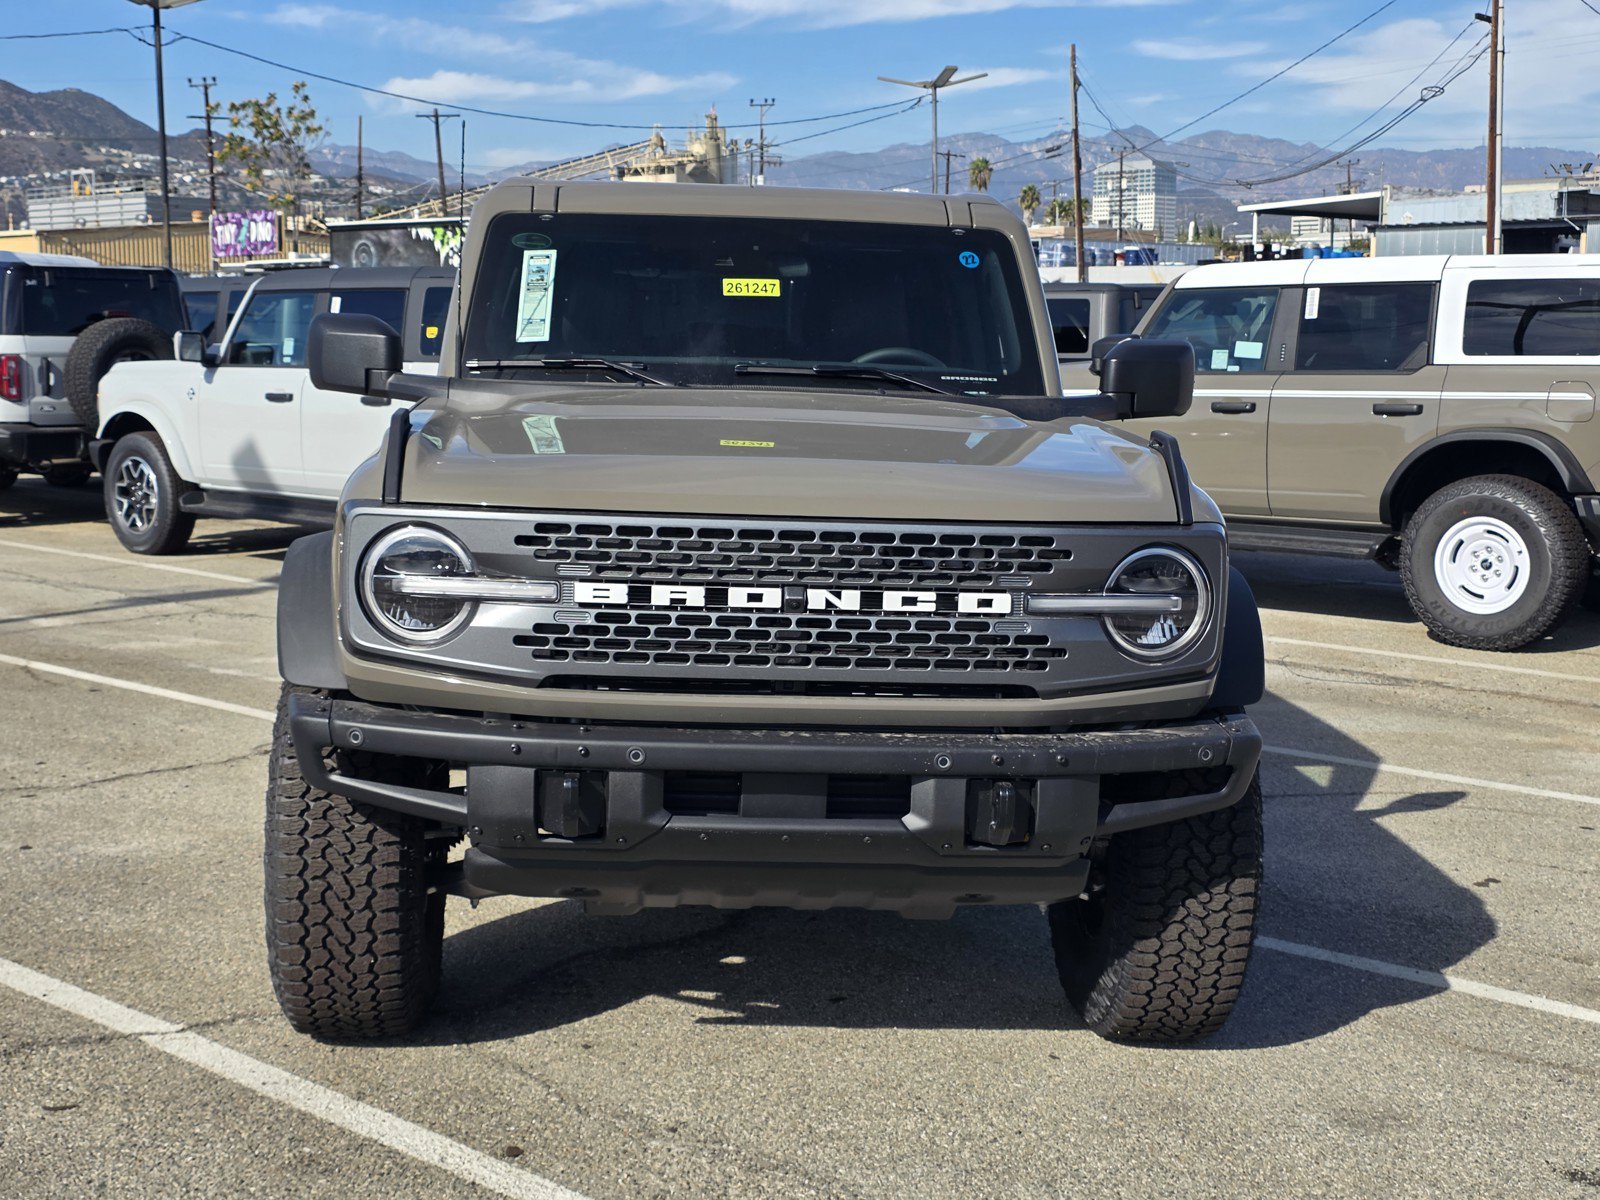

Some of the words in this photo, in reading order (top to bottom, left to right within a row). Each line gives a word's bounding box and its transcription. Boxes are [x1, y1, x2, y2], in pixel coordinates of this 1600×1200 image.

[215, 222, 237, 247] TINY
[249, 220, 273, 243] DINO
[726, 282, 776, 294] 261247
[574, 581, 1012, 615] BRONCO
